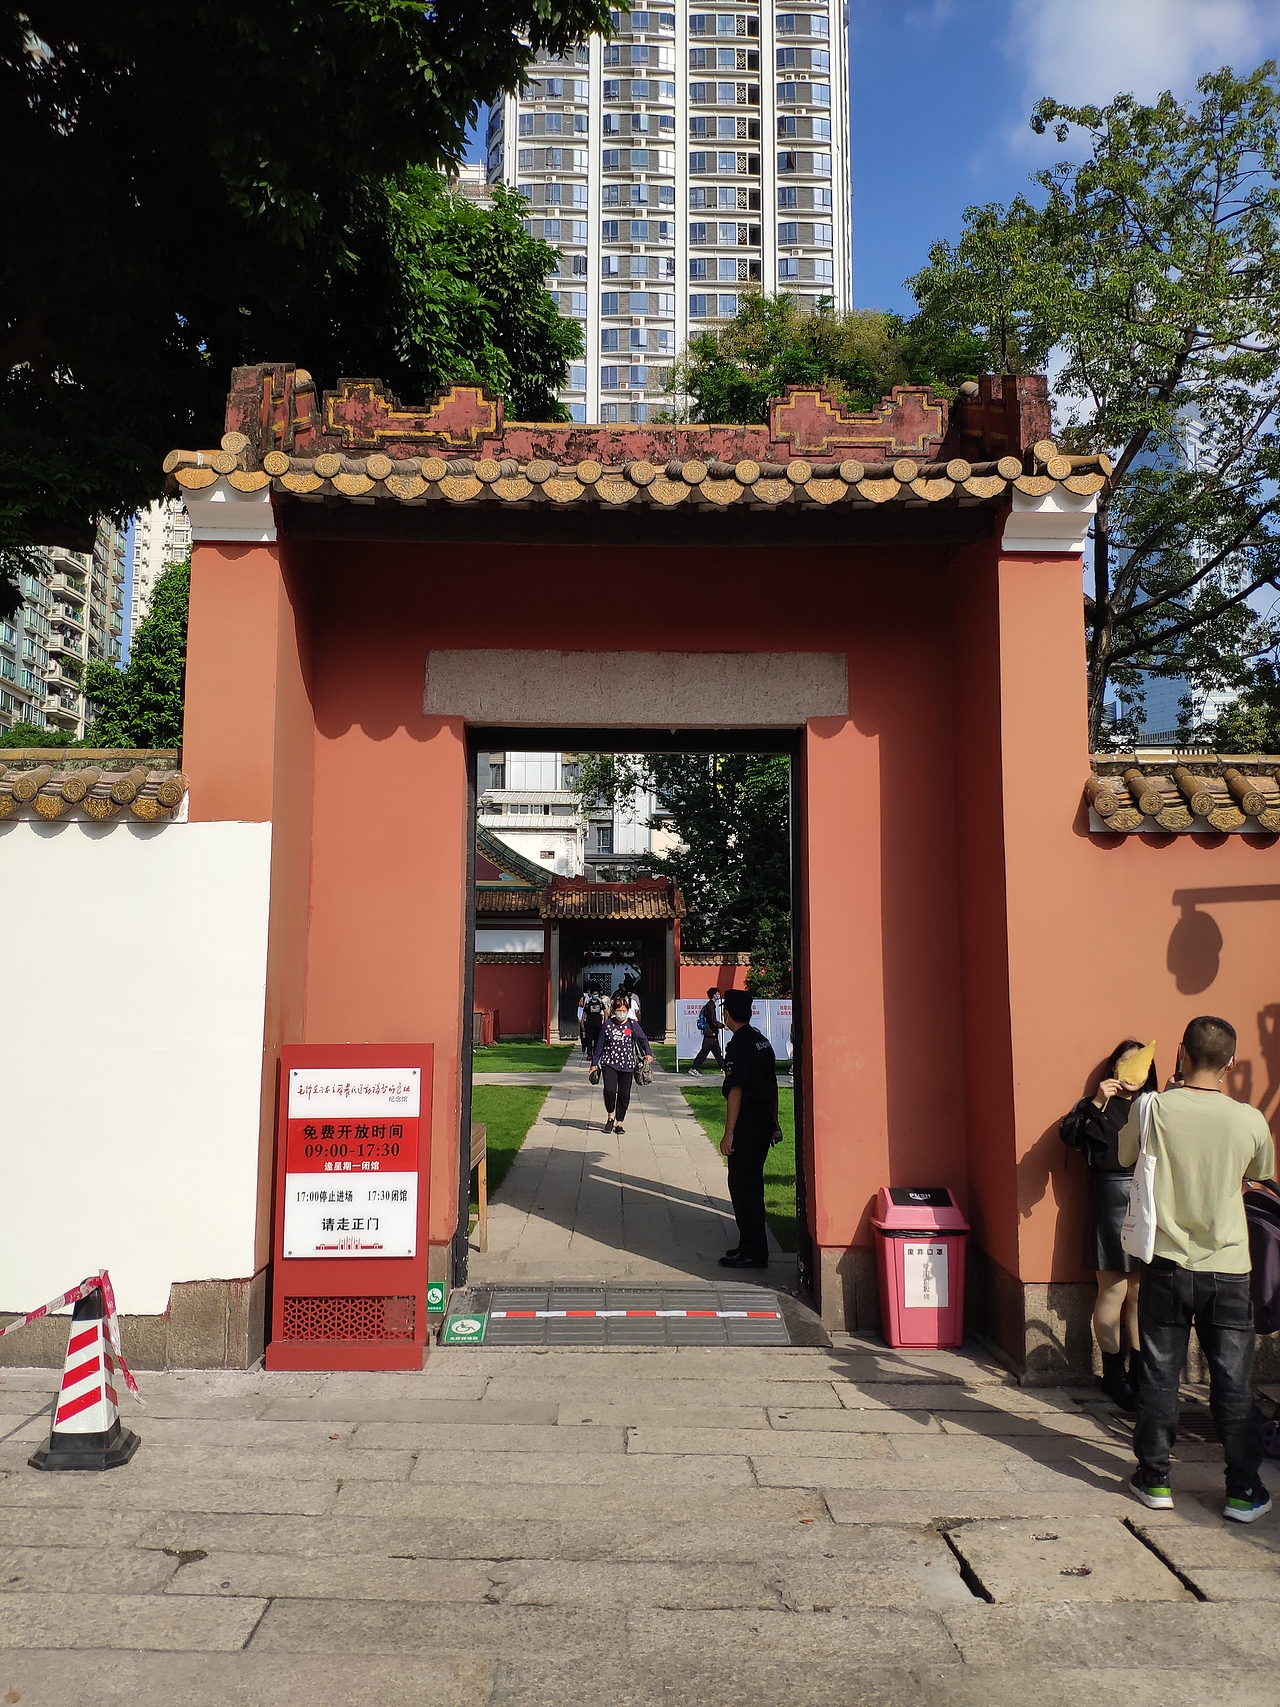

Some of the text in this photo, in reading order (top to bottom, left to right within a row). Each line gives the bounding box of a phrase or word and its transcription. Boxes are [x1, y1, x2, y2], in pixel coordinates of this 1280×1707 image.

[388, 1095, 408, 1103] 纪念馆
[303, 1124, 403, 1140] 免费开放时间
[304, 1143, 400, 1157] 09:00-17:30
[324, 1161, 380, 1171] 逢星期一闭馆
[296, 1189, 408, 1203] 17:00停止进场 17:30闭馆
[321, 1217, 379, 1231] 请走正门
